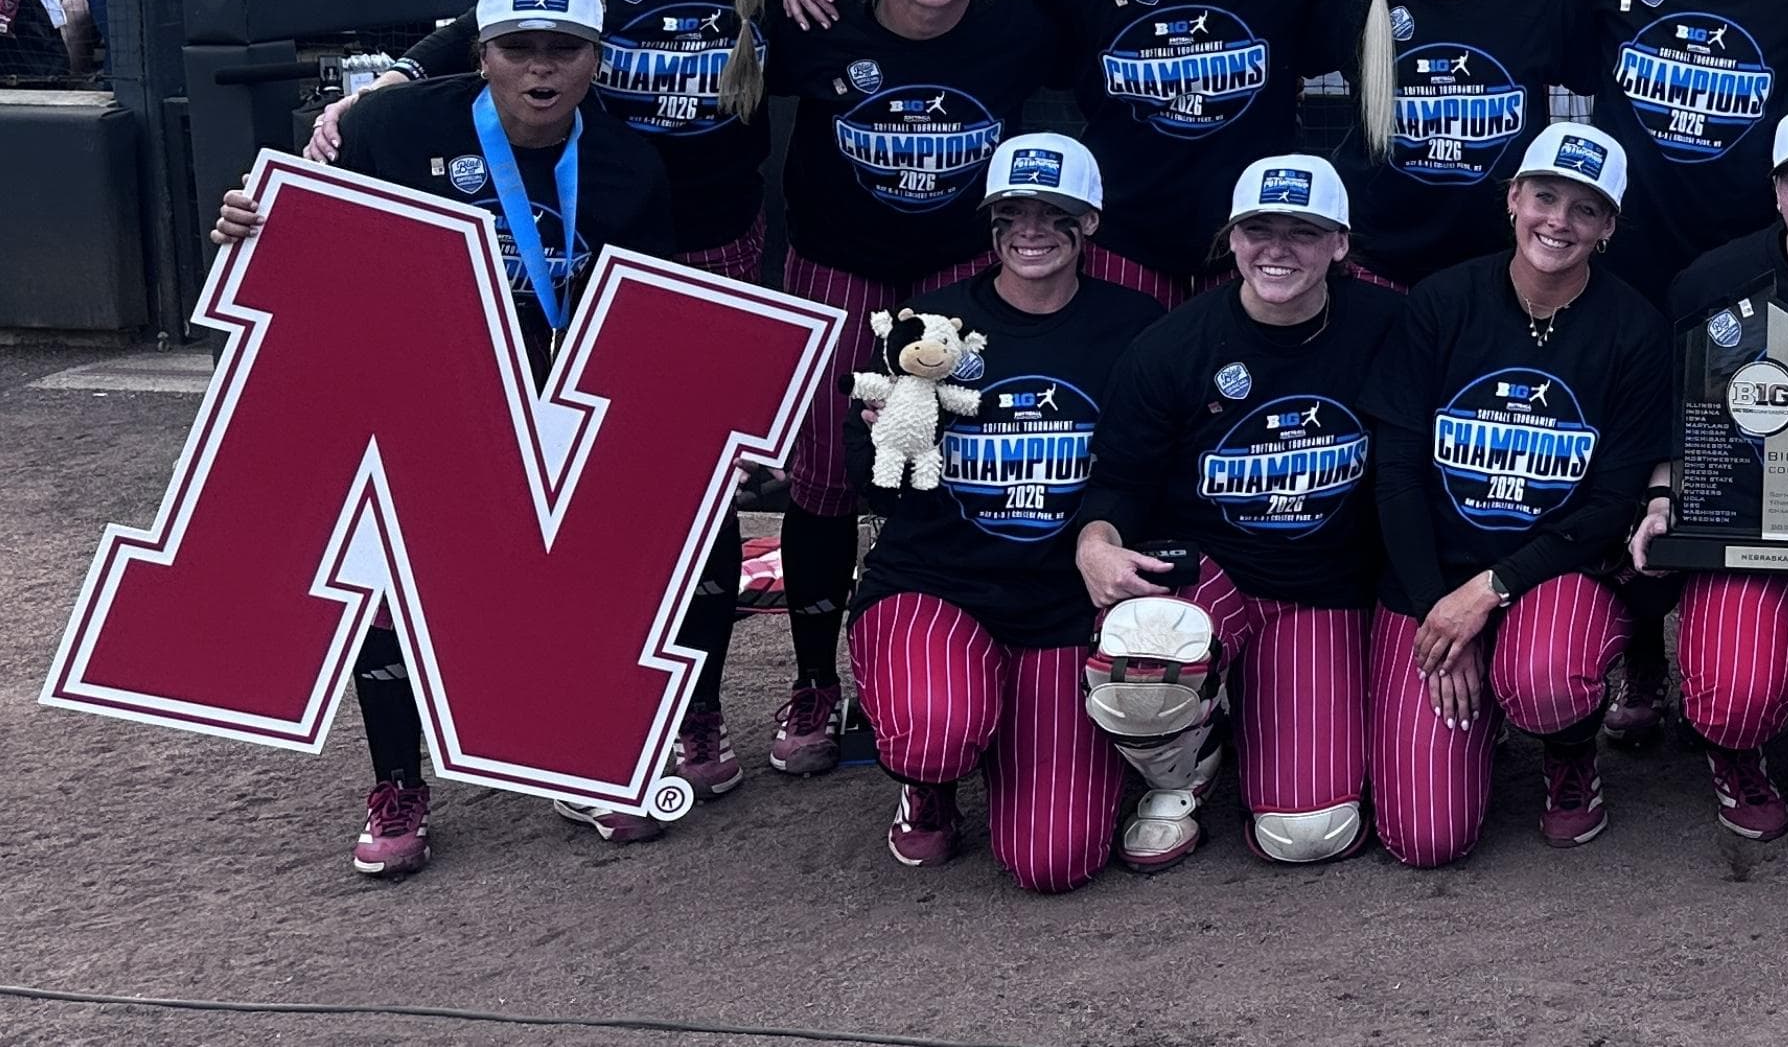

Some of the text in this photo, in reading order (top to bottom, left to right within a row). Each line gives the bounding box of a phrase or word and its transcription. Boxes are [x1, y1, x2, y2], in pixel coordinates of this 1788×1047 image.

[598, 45, 765, 95] CHAMPIO
[1105, 45, 1264, 101] CHAMPIONS
[1622, 53, 1769, 115] CHAMPIONS
[657, 96, 698, 120] 2026
[1170, 94, 1203, 117] 2026
[1395, 93, 1521, 139] AMPIONS
[1669, 111, 1705, 134] 2026
[840, 127, 1000, 171] CHAMPIONS
[1428, 139, 1462, 161] 2026
[899, 171, 936, 191] 2026
[944, 435, 1094, 483] CHAMPION
[1439, 419, 1592, 478] CHAMPIONS
[38, 147, 847, 818] N
[1207, 441, 1368, 495] CHAMPIONS
[1006, 485, 1045, 509] 2026
[1266, 495, 1306, 514] 2026
[1487, 476, 1526, 502] 2026
[1741, 554, 1788, 562] NEBRASKA
